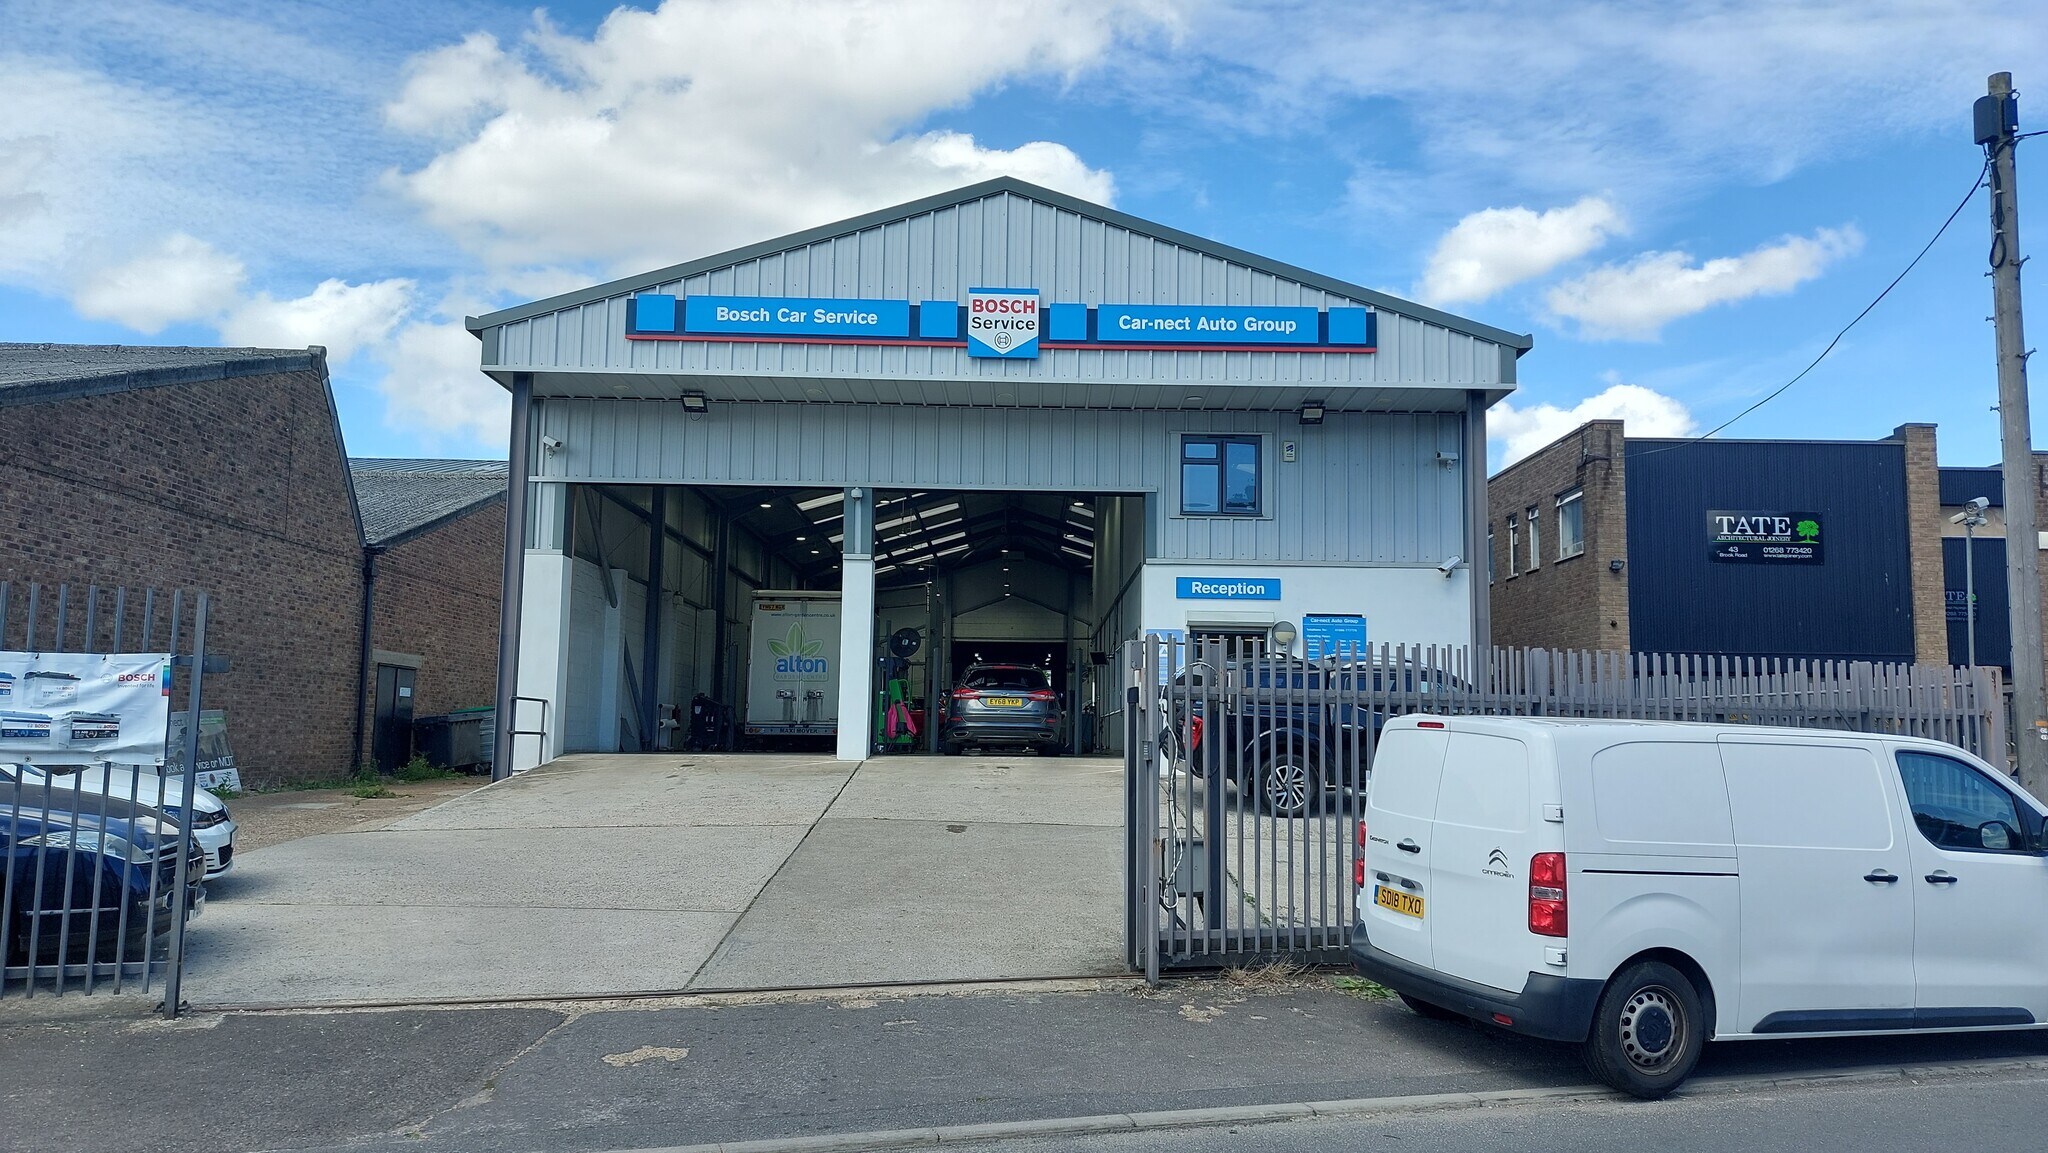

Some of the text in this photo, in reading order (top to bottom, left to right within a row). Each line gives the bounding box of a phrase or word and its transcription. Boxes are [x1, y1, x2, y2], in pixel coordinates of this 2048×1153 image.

[972, 299, 1035, 314] BOSCH
[716, 306, 878, 325] Bosch Car Service
[971, 316, 1036, 330] Service
[1118, 315, 1297, 334] Car-nect Auto Group
[1715, 516, 1791, 536] TATE
[1191, 581, 1265, 596] Reception
[1945, 591, 1966, 601] TE
[776, 655, 827, 673] alton
[118, 673, 156, 682] BOSCH
[166, 762, 178, 773] ook
[195, 759, 210, 769] vice
[210, 760, 218, 768] or
[1381, 888, 1421, 914] SD18 TXO
